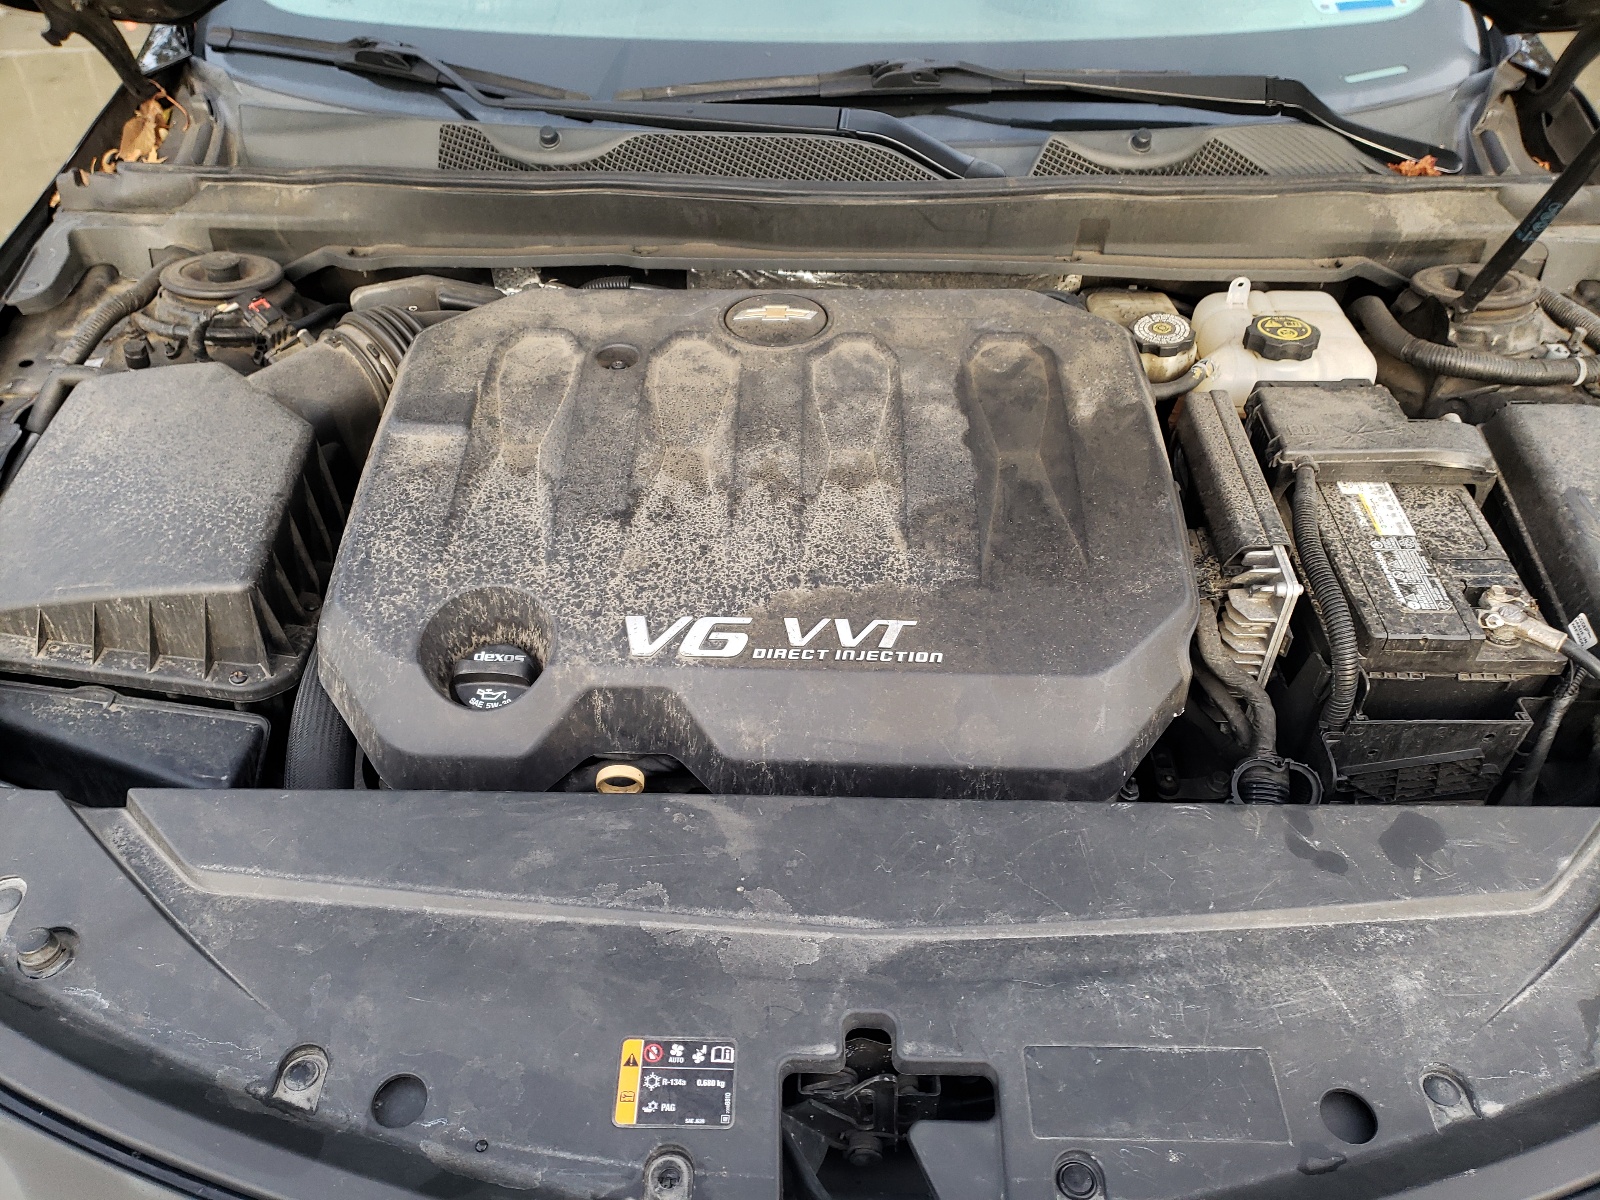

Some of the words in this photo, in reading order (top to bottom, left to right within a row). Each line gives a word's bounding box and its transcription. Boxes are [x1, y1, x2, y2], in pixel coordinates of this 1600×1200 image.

[625, 615, 753, 658] V6
[783, 617, 918, 649] VVT
[473, 651, 527, 662] dexos
[752, 648, 829, 661] DIRECT
[834, 649, 943, 663] INJECTION
[468, 697, 485, 709] SAE
[661, 1078, 687, 1086] R-134a
[716, 1080, 726, 1088] kg
[660, 1103, 676, 1112] PAG
